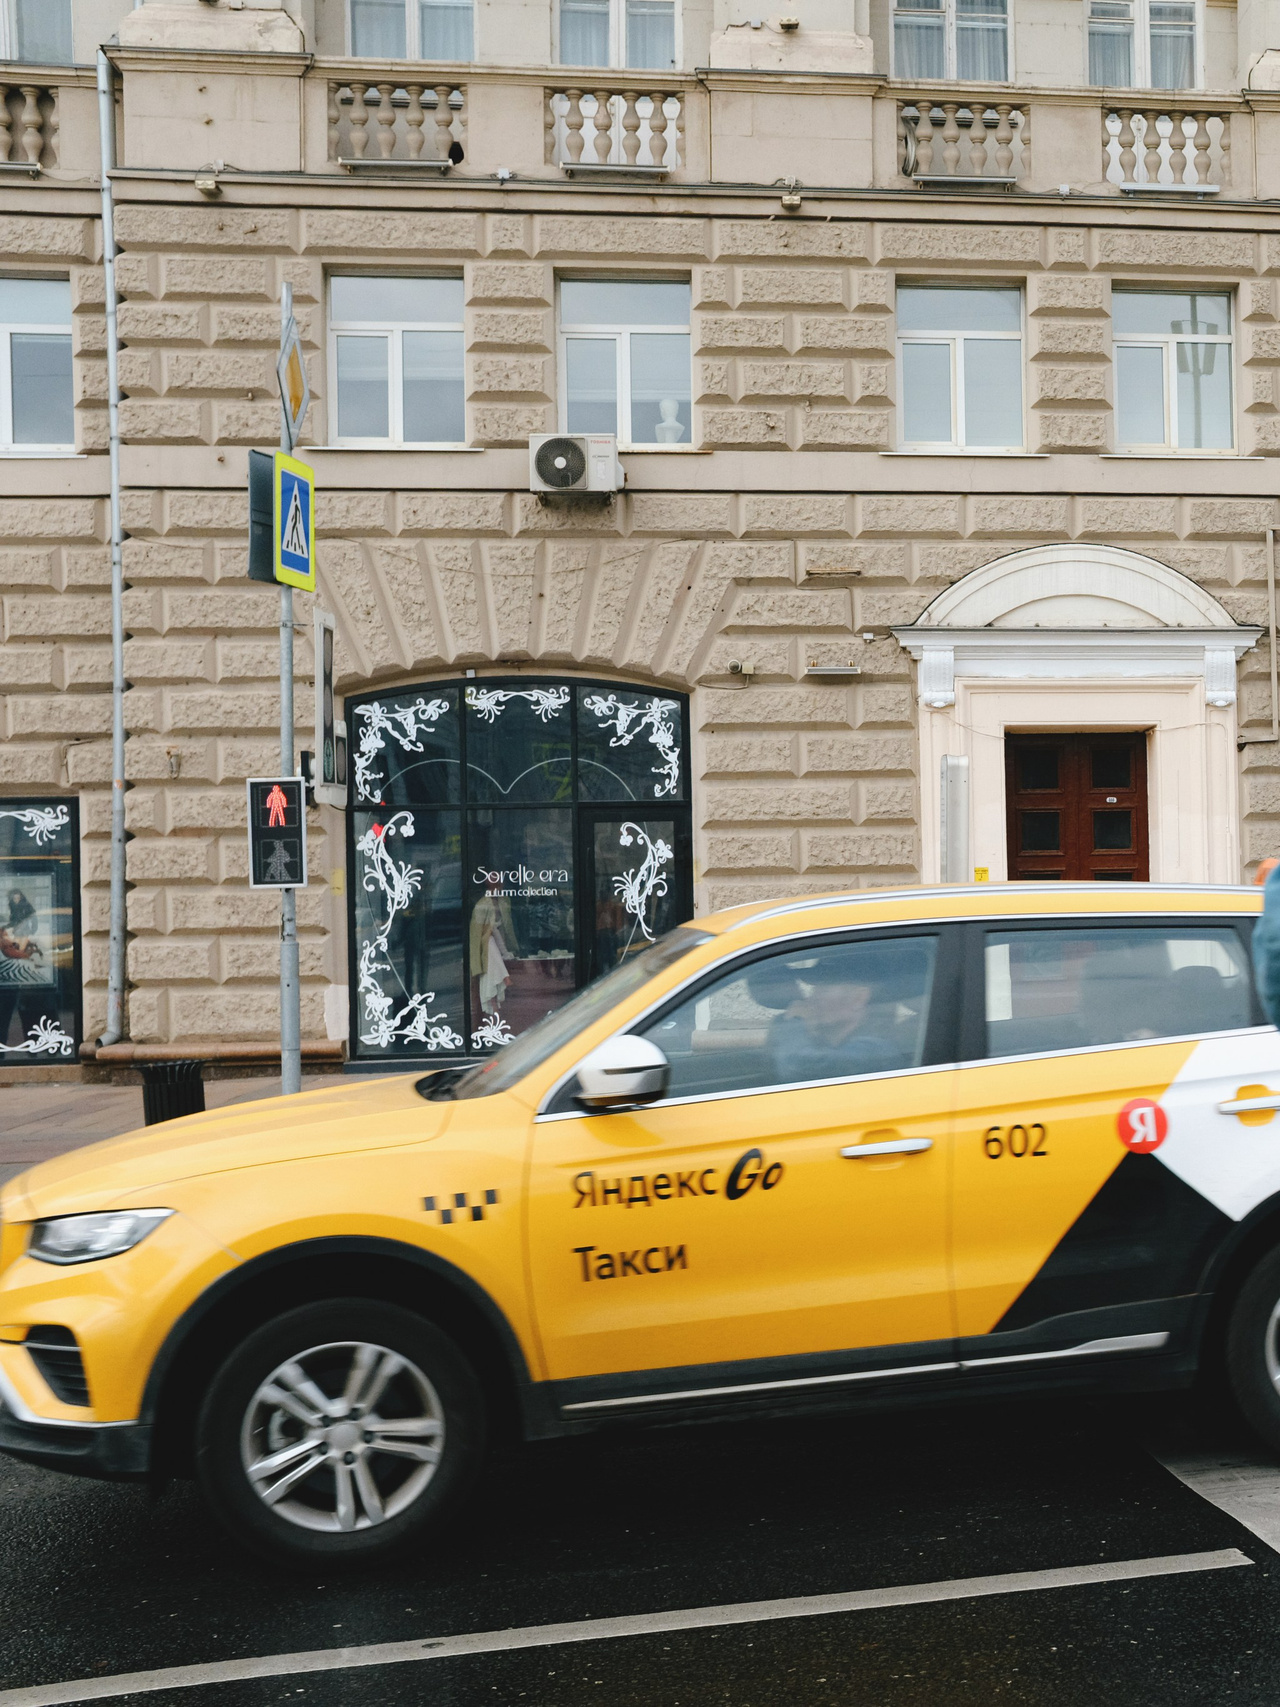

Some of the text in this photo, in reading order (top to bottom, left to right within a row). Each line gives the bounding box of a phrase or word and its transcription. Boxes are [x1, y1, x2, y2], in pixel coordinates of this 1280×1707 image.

[472, 863, 568, 886] Sorelle era
[485, 886, 558, 898] autumn collection
[984, 1123, 1048, 1160] 602
[1127, 1106, 1158, 1144] Я
[572, 1148, 784, 1209] Яндекс Go
[572, 1244, 688, 1282] Такси
